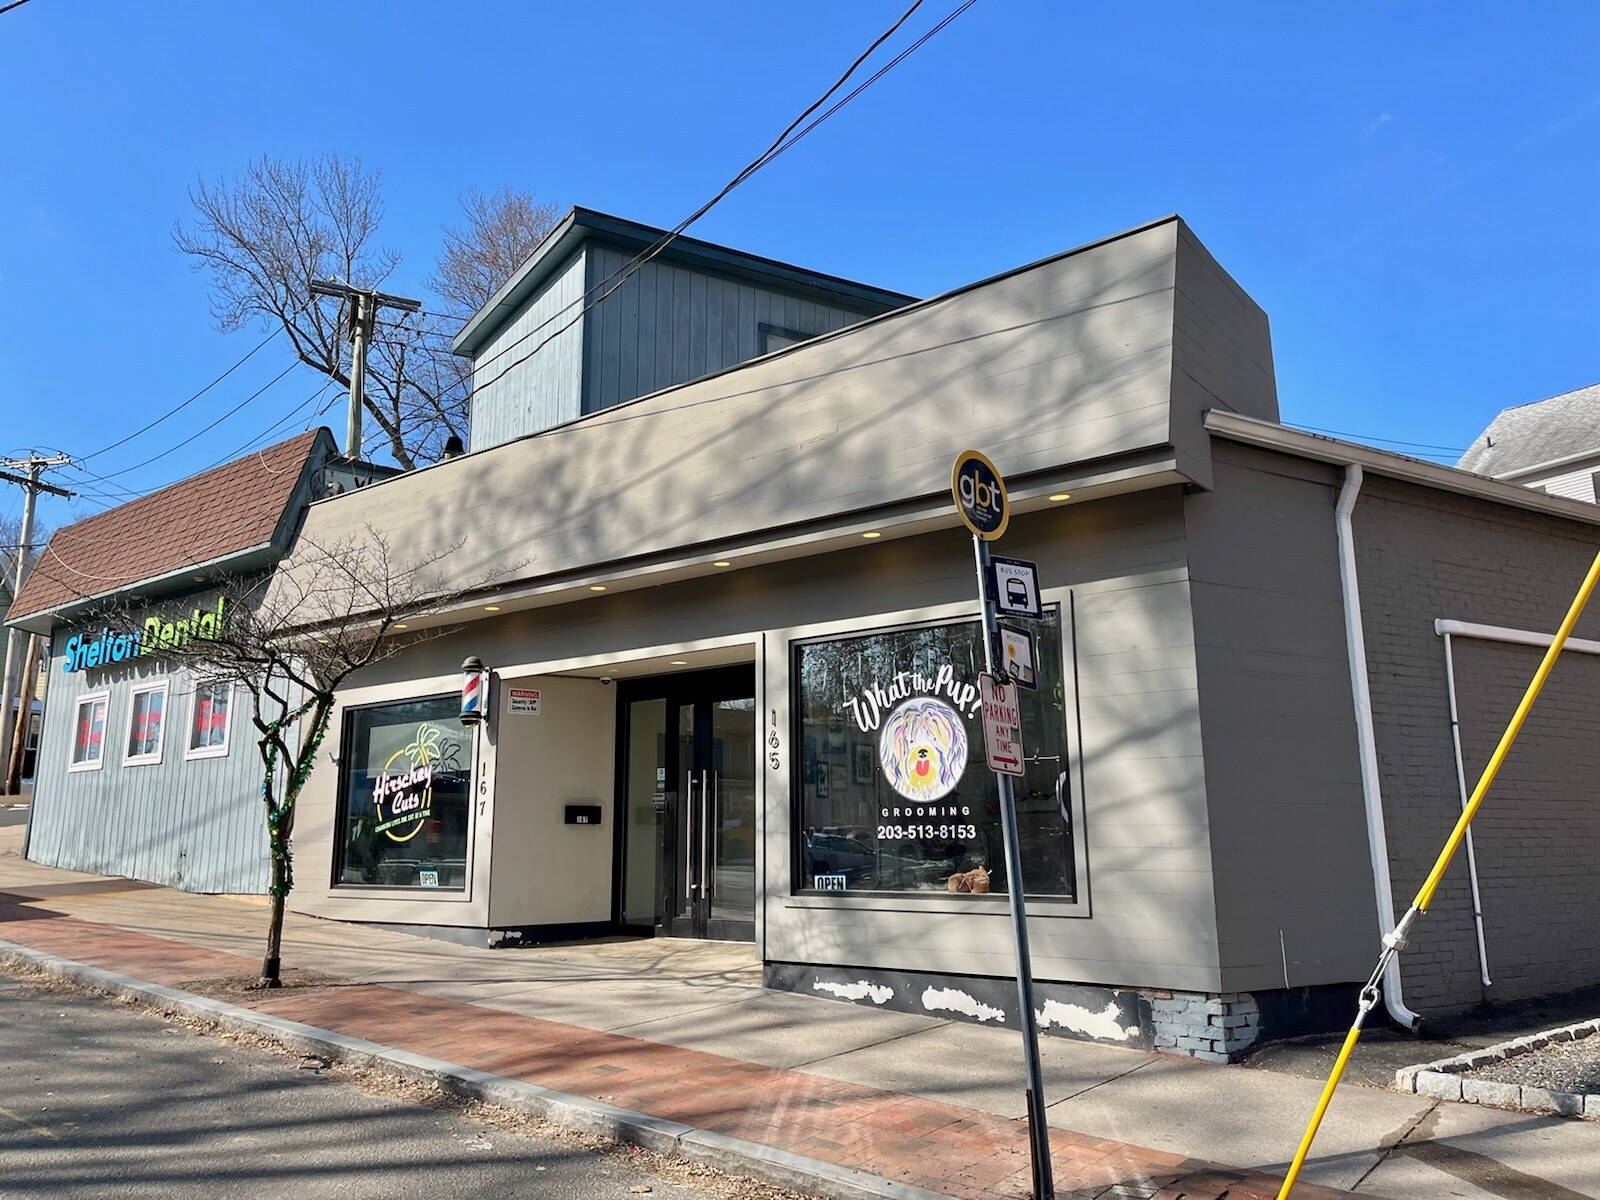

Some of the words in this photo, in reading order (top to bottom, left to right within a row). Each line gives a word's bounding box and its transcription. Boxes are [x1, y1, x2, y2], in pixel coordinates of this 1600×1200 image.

[960, 469, 1000, 513] gbt
[1000, 567, 1012, 575] BUS
[1014, 568, 1030, 577] STOP
[63, 626, 141, 672] Shelton
[140, 595, 225, 655] Dental
[1006, 633, 1025, 645] ROUTES
[991, 683, 1006, 702] NO
[842, 671, 911, 733] What
[909, 672, 935, 693] the
[984, 702, 1017, 726] PARKING
[768, 709, 780, 770] 165
[995, 725, 1009, 738] ANY
[995, 739, 1012, 753] TIME
[479, 762, 487, 816] 167
[392, 791, 420, 814] Cuts
[881, 806, 970, 818] GROOMING
[877, 824, 977, 840] 203-513-8153
[421, 873, 437, 886] OPEN
[817, 876, 845, 890] OPEN
